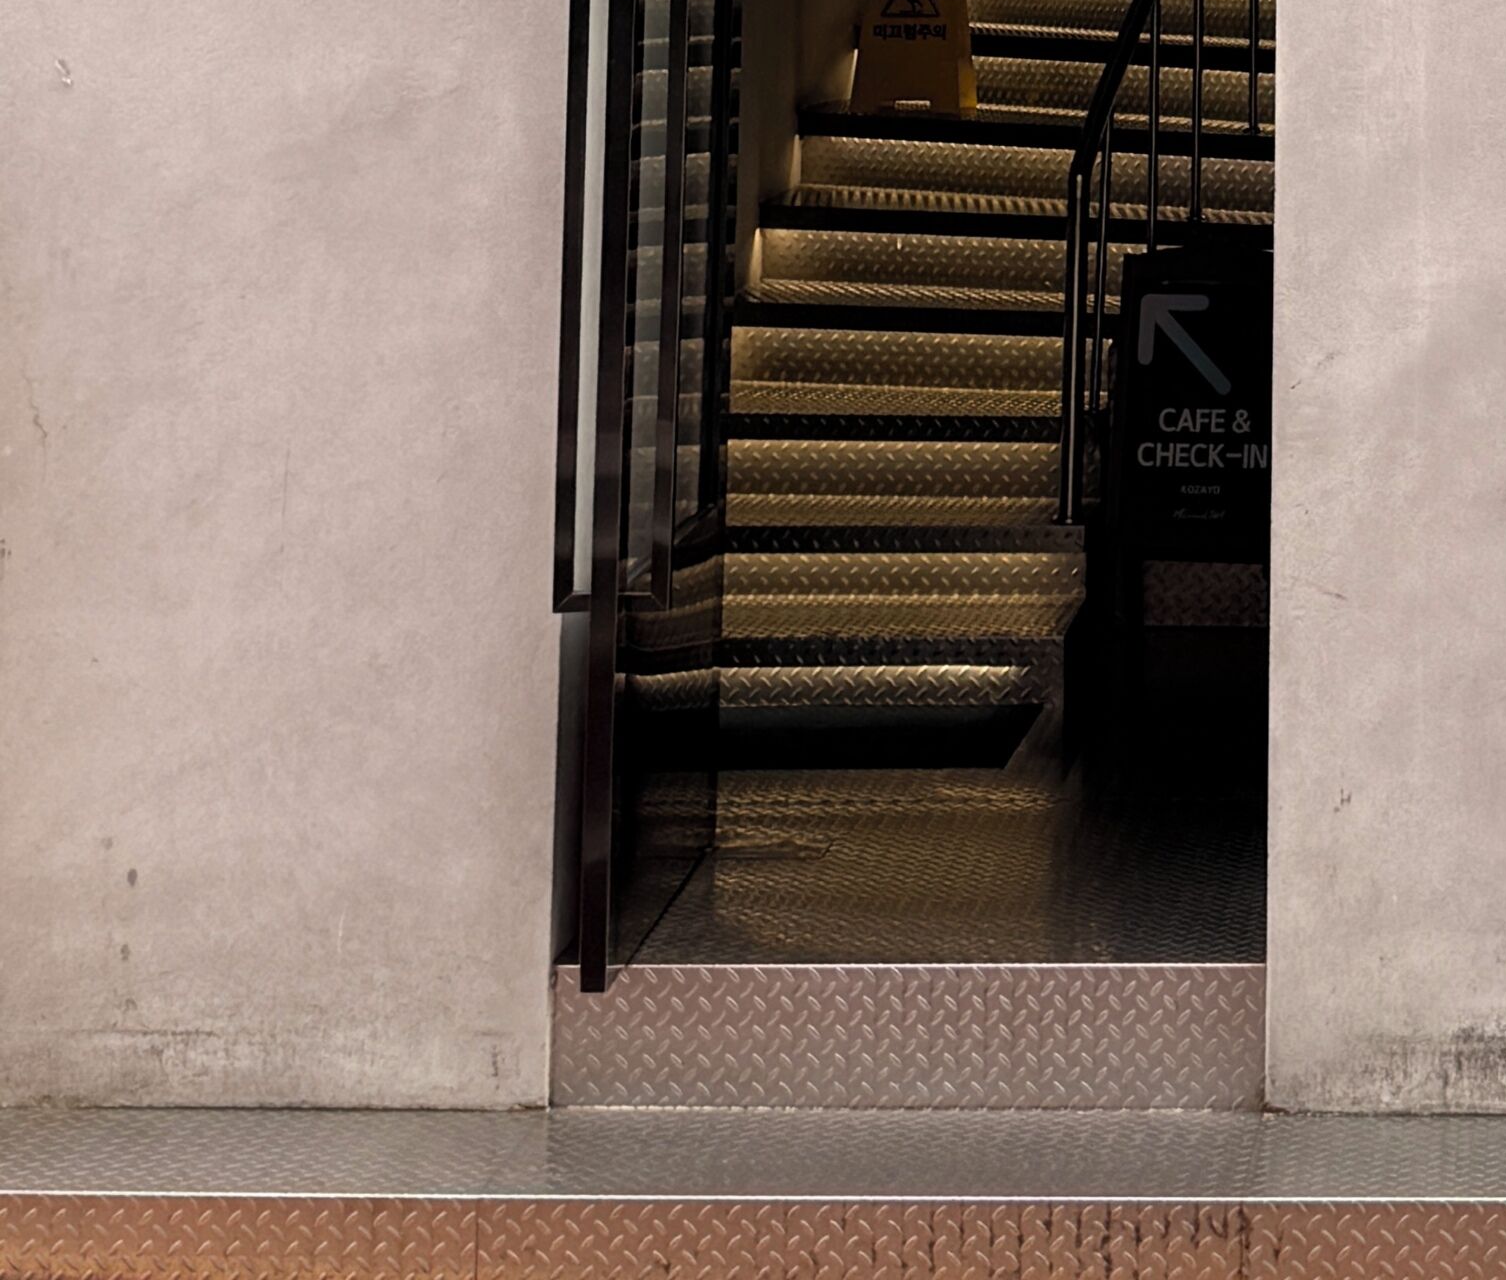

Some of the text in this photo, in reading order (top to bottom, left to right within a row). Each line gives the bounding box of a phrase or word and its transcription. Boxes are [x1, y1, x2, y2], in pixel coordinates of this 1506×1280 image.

[1158, 407, 1252, 434] CAFE &
[1136, 441, 1269, 470] CHECK-IN
